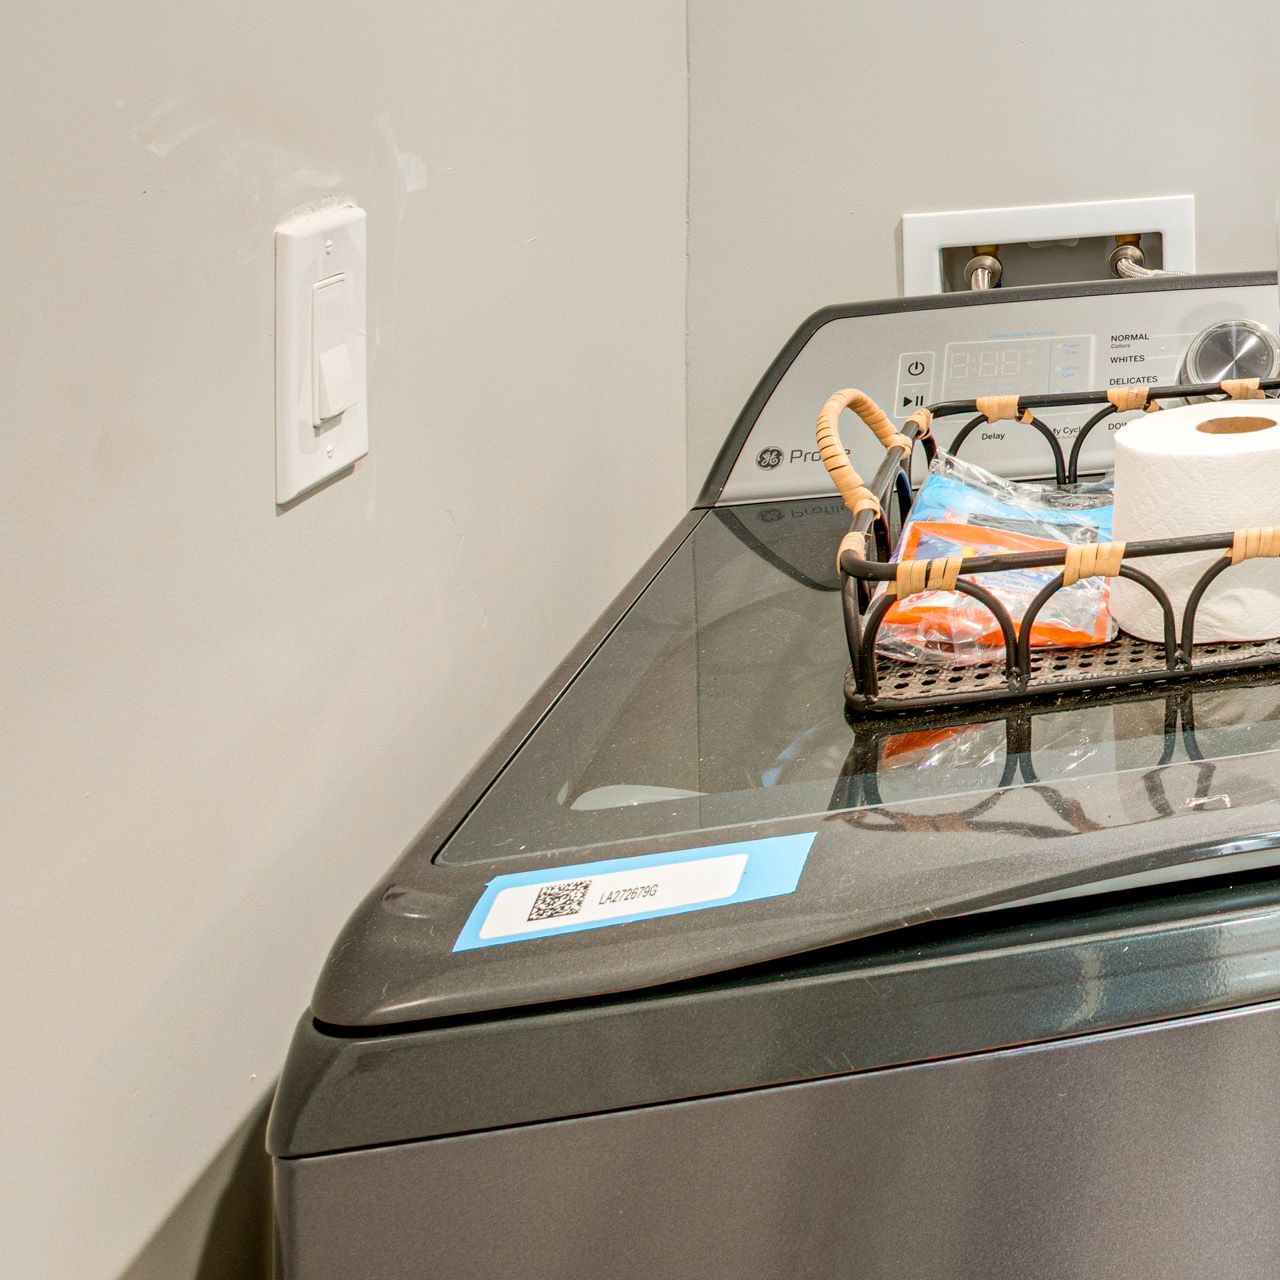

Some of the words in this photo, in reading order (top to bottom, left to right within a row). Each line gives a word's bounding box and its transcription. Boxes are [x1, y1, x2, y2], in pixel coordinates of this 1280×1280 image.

[1110, 333, 1150, 342] NORMAL
[1110, 355, 1145, 364] WHITES
[1109, 376, 1158, 386] DELICATES
[1063, 426, 1082, 435] Cycl
[981, 432, 1005, 441] Delay
[599, 884, 659, 906] LA272679G
